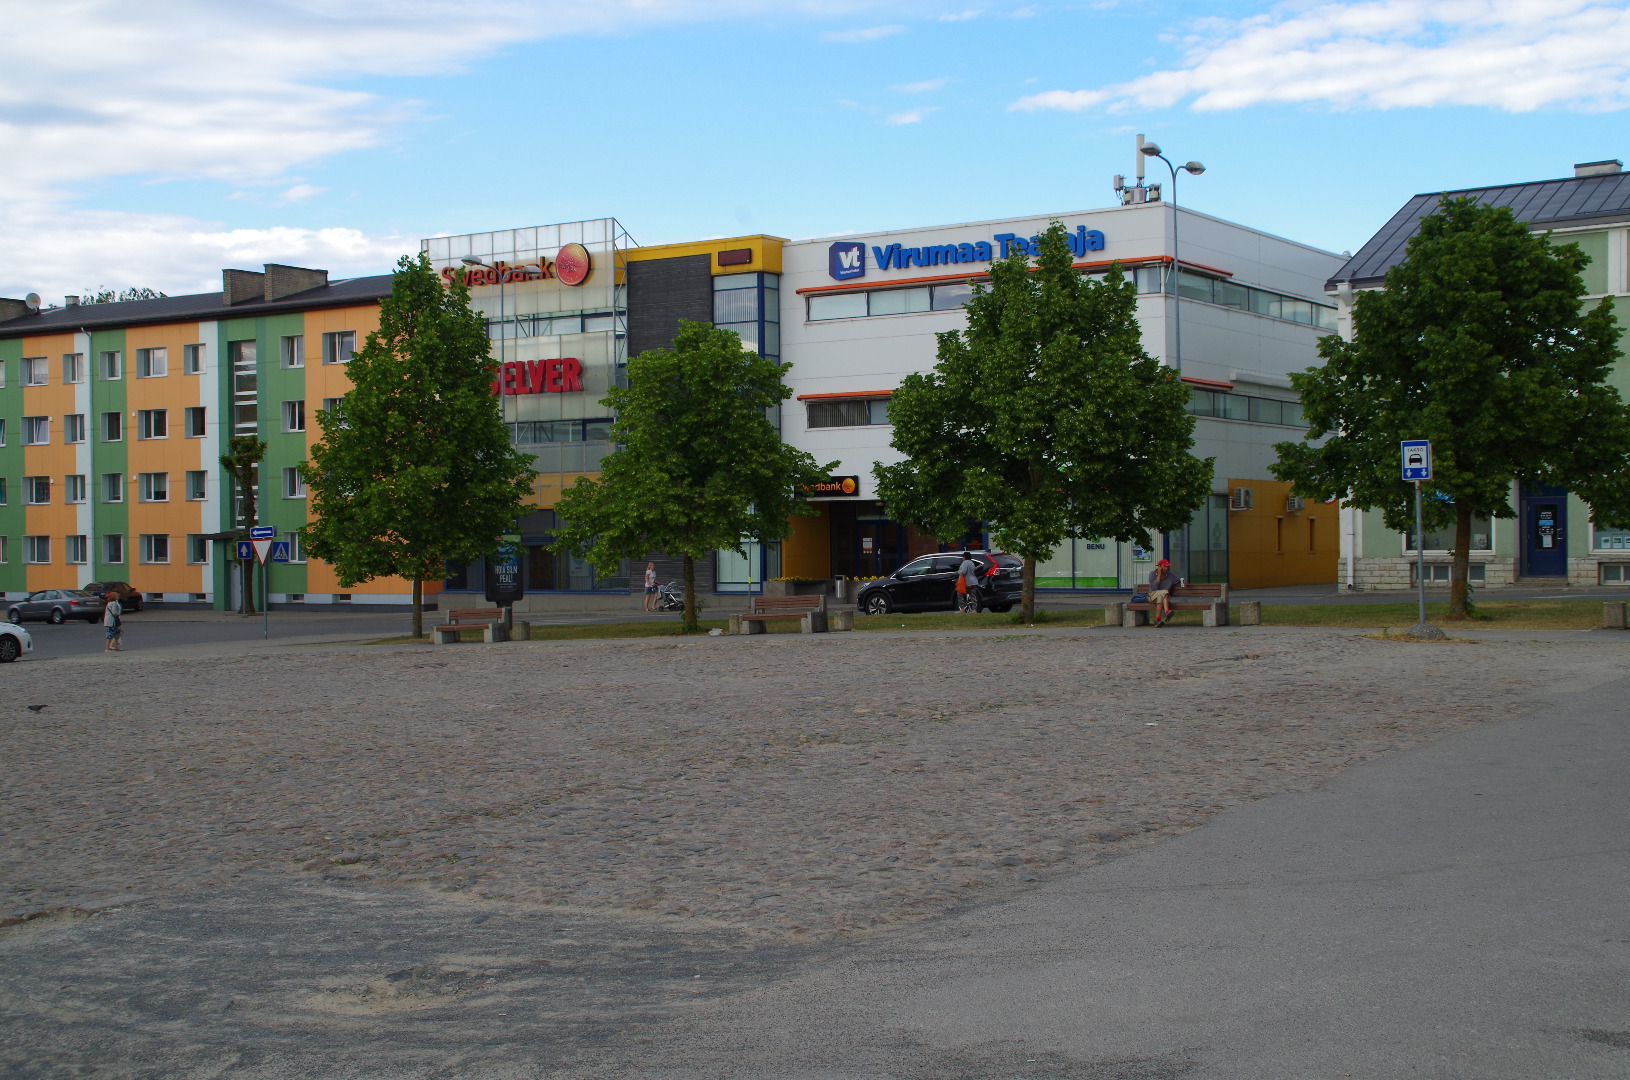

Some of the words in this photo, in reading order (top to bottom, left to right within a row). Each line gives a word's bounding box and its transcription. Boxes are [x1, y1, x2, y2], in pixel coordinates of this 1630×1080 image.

[839, 246, 861, 269] vt
[872, 238, 992, 270] Virumaa
[994, 225, 1105, 261] Teaaja
